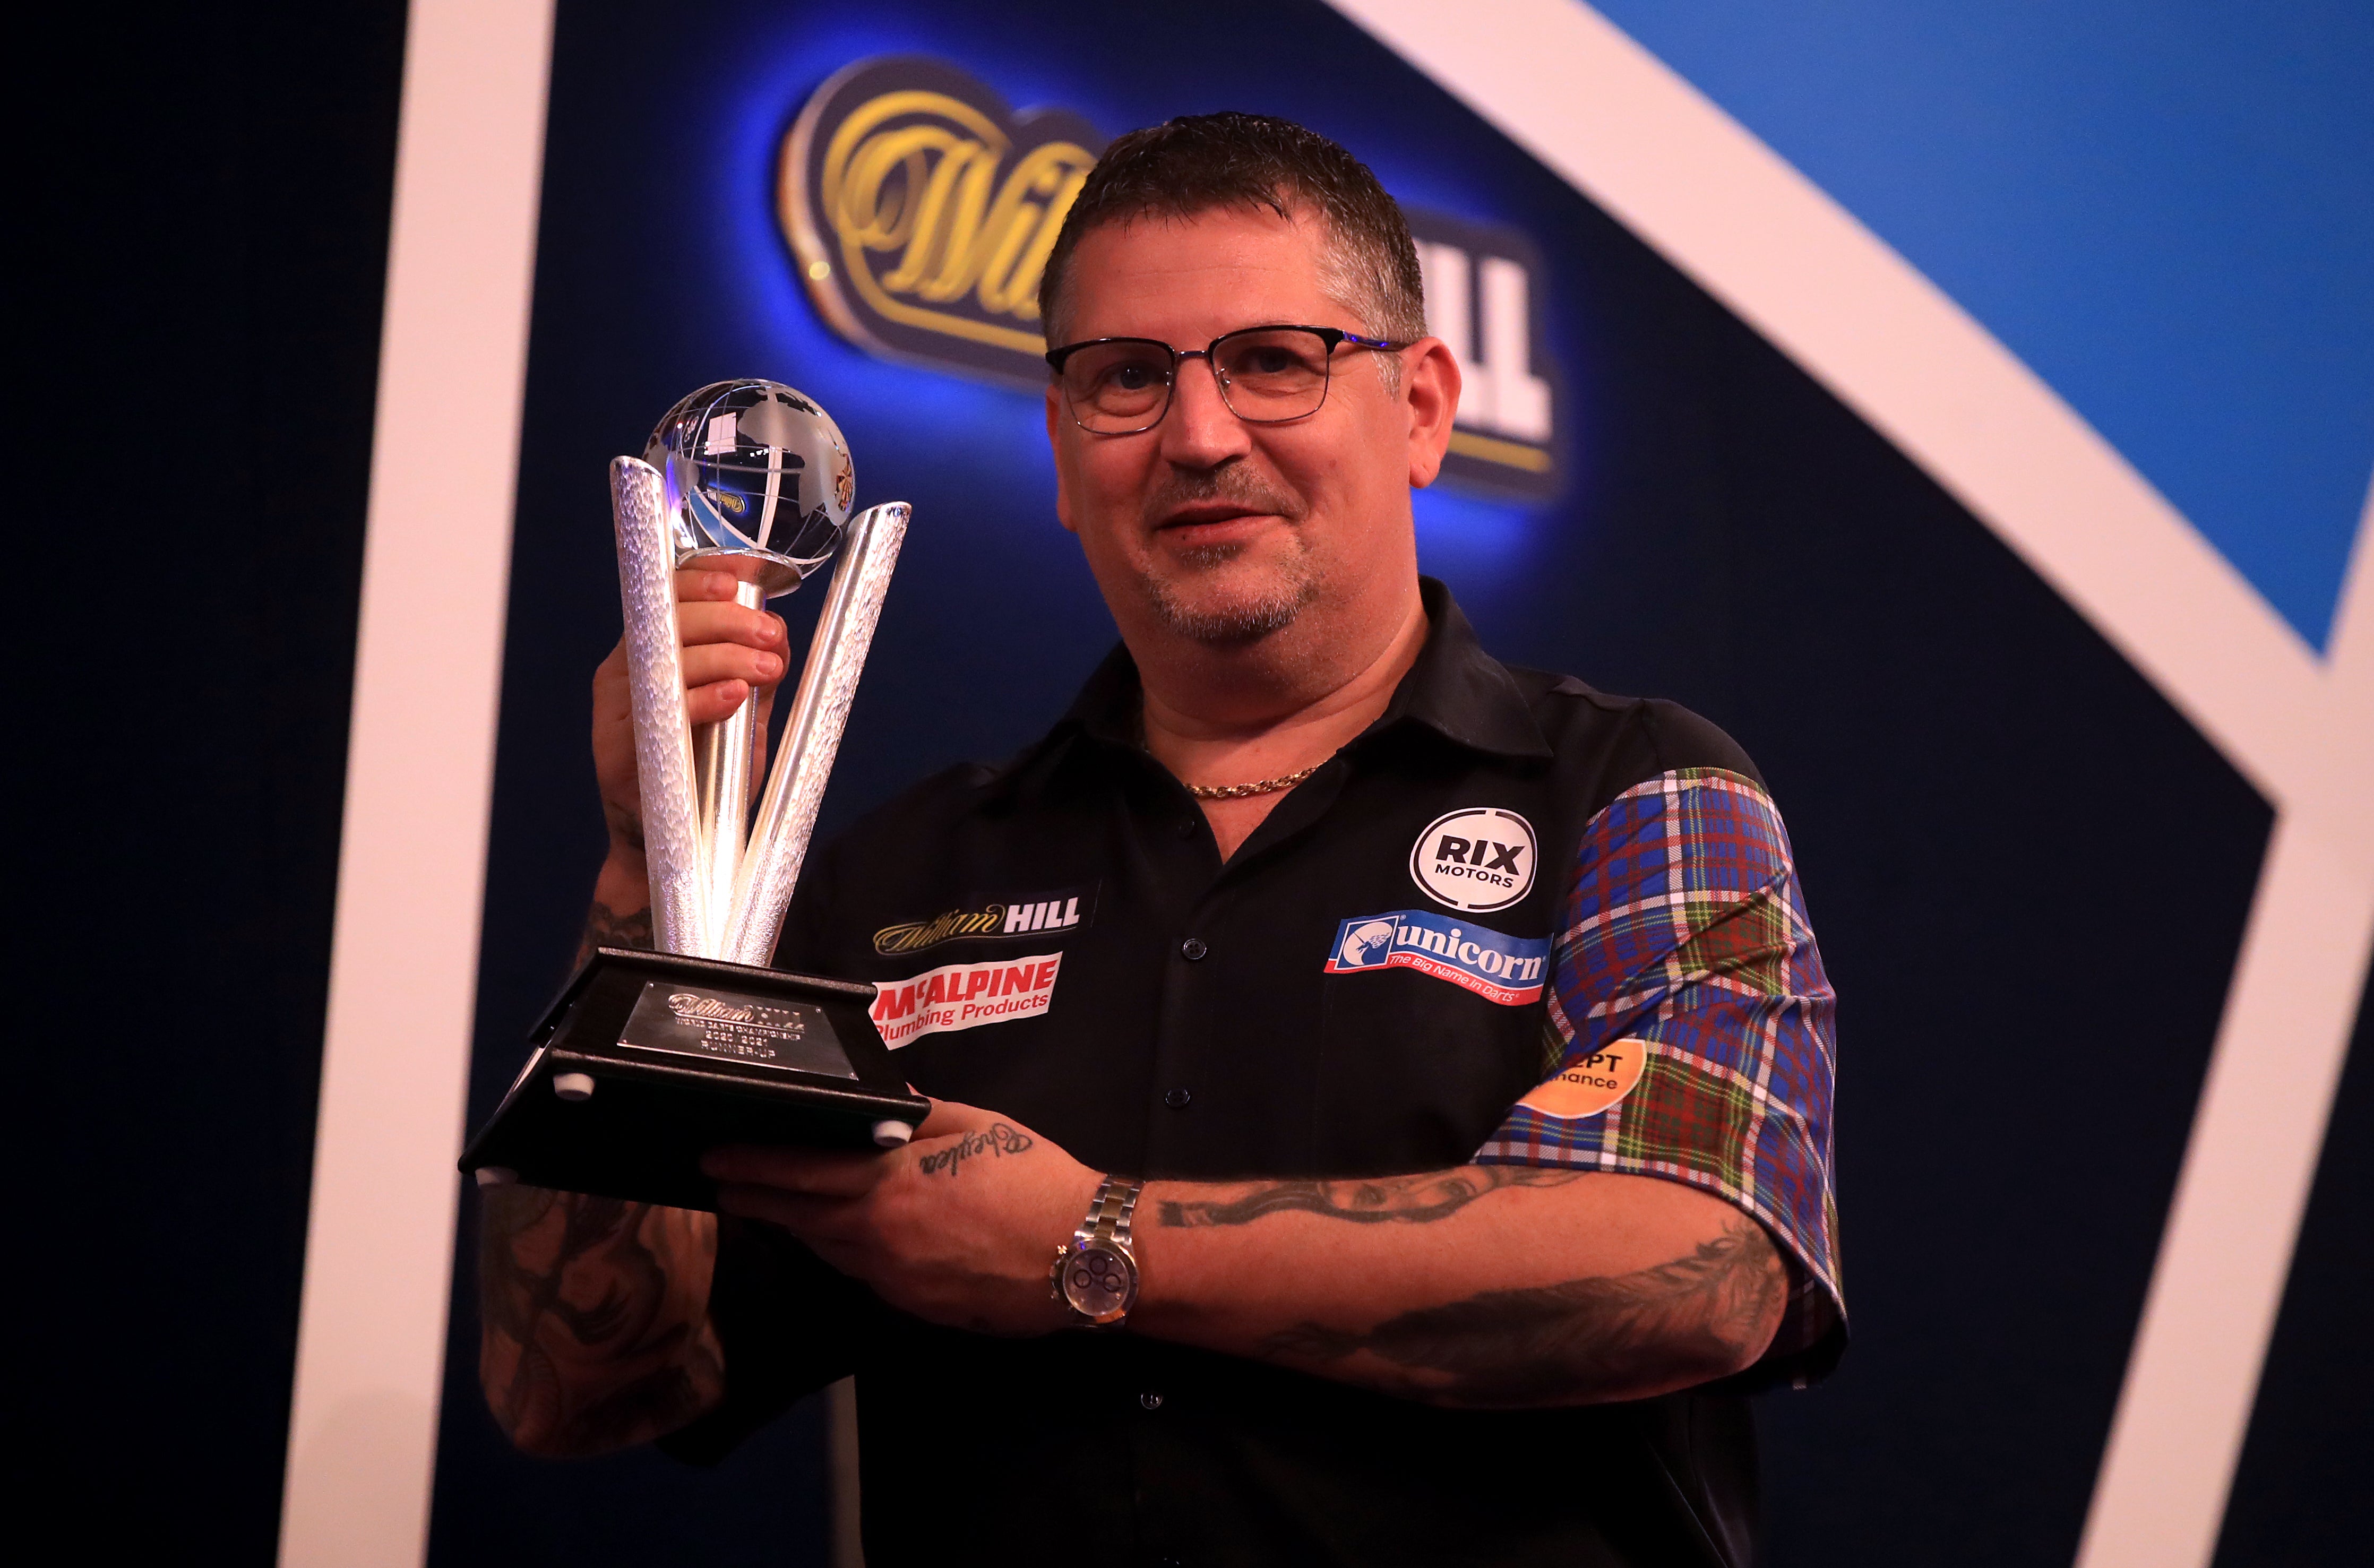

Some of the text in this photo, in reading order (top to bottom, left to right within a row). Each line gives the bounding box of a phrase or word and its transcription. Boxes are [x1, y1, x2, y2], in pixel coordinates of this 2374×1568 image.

[1434, 863, 1515, 889] MOTORS
[1435, 834, 1525, 876] RIX
[873, 897, 1080, 955] William HILL
[1397, 924, 1542, 981] unicorn
[1389, 954, 1516, 1002] The Big Name in Darts
[668, 993, 754, 1022] William
[961, 992, 1048, 1021] Products
